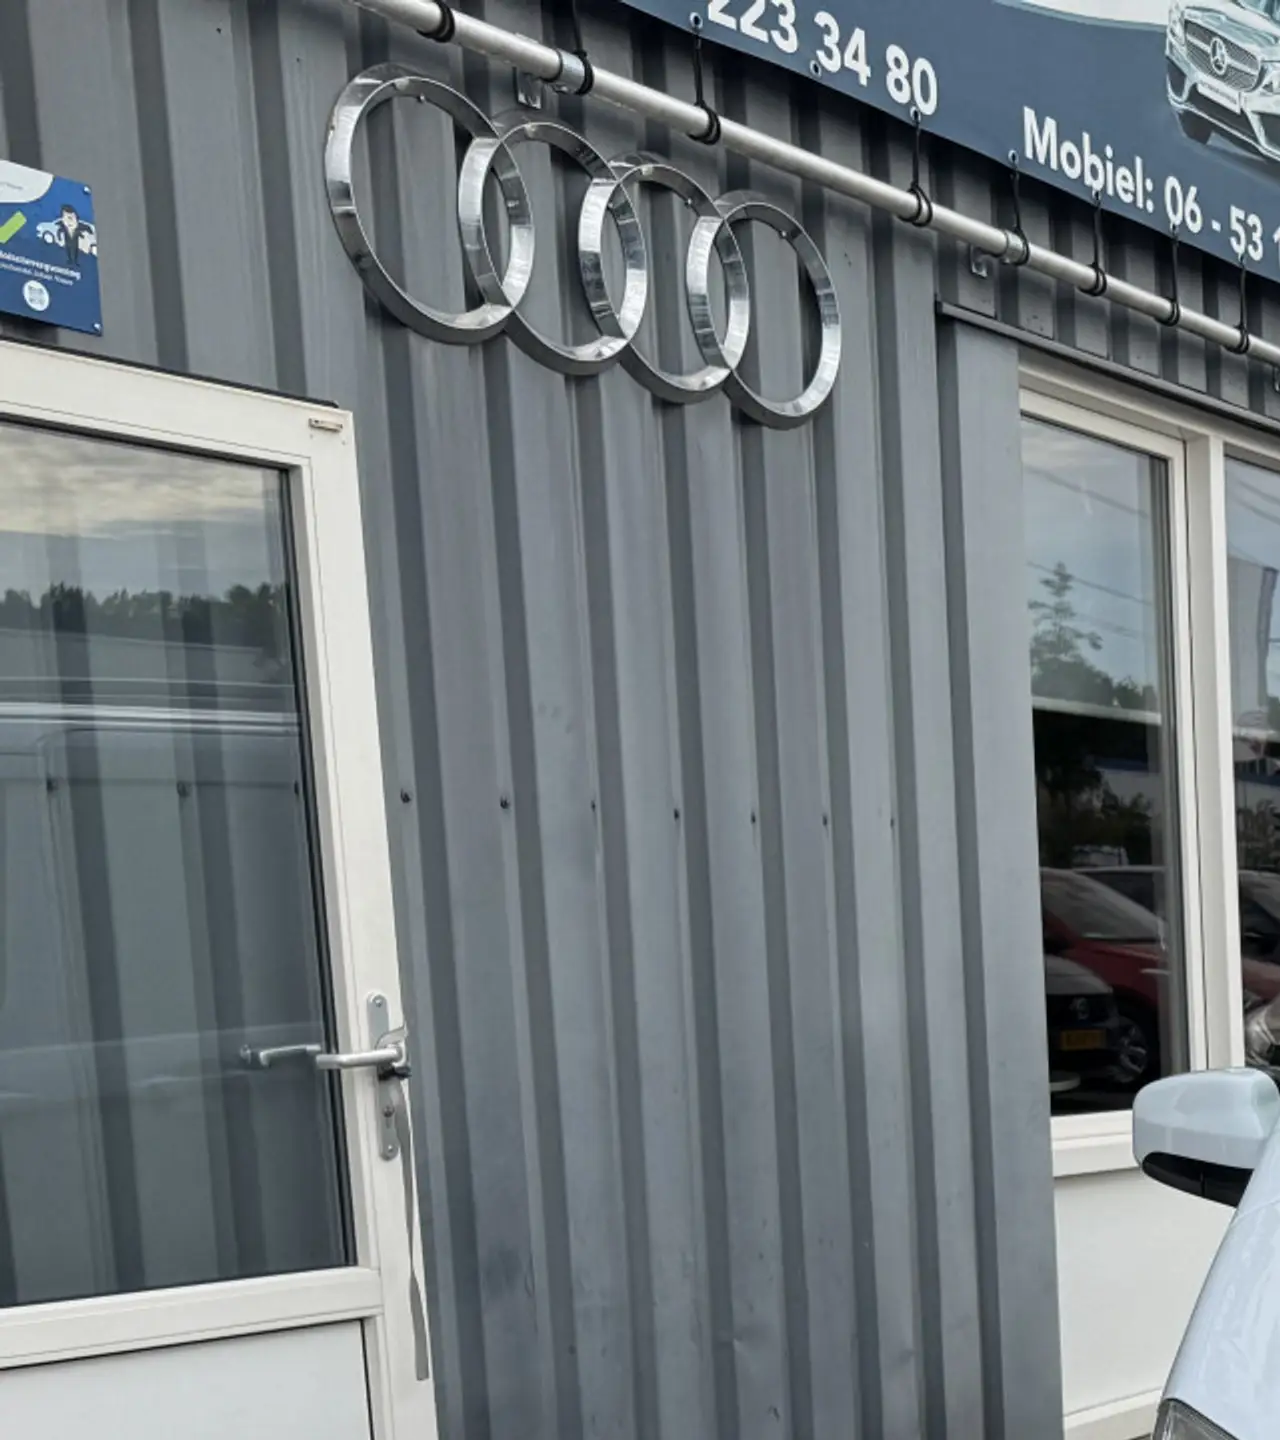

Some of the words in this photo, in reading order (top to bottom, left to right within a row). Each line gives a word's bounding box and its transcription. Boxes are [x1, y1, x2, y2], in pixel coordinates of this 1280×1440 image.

[813, 10, 872, 87] 34
[885, 43, 938, 116] 80
[1023, 105, 1154, 214] Mobiel:
[1164, 175, 1203, 234] 06
[1229, 204, 1264, 262] 53
